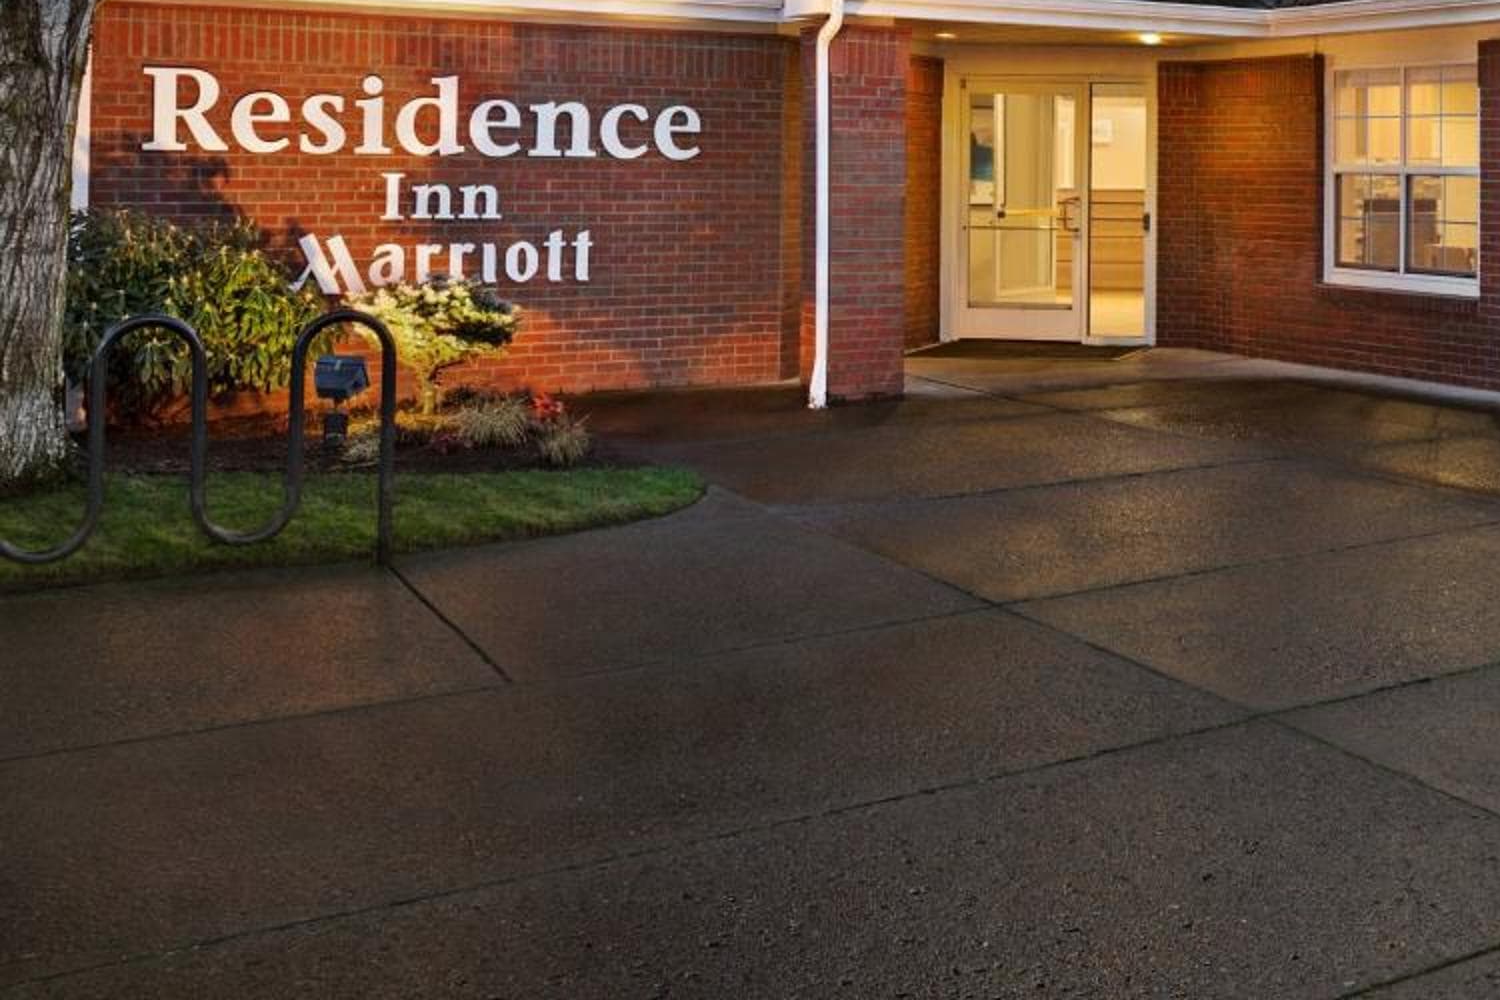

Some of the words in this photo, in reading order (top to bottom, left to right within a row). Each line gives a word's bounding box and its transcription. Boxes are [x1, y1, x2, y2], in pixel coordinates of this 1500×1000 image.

[141, 66, 702, 160] Residence
[380, 172, 502, 220] Inn
[289, 229, 594, 295] Marriott
